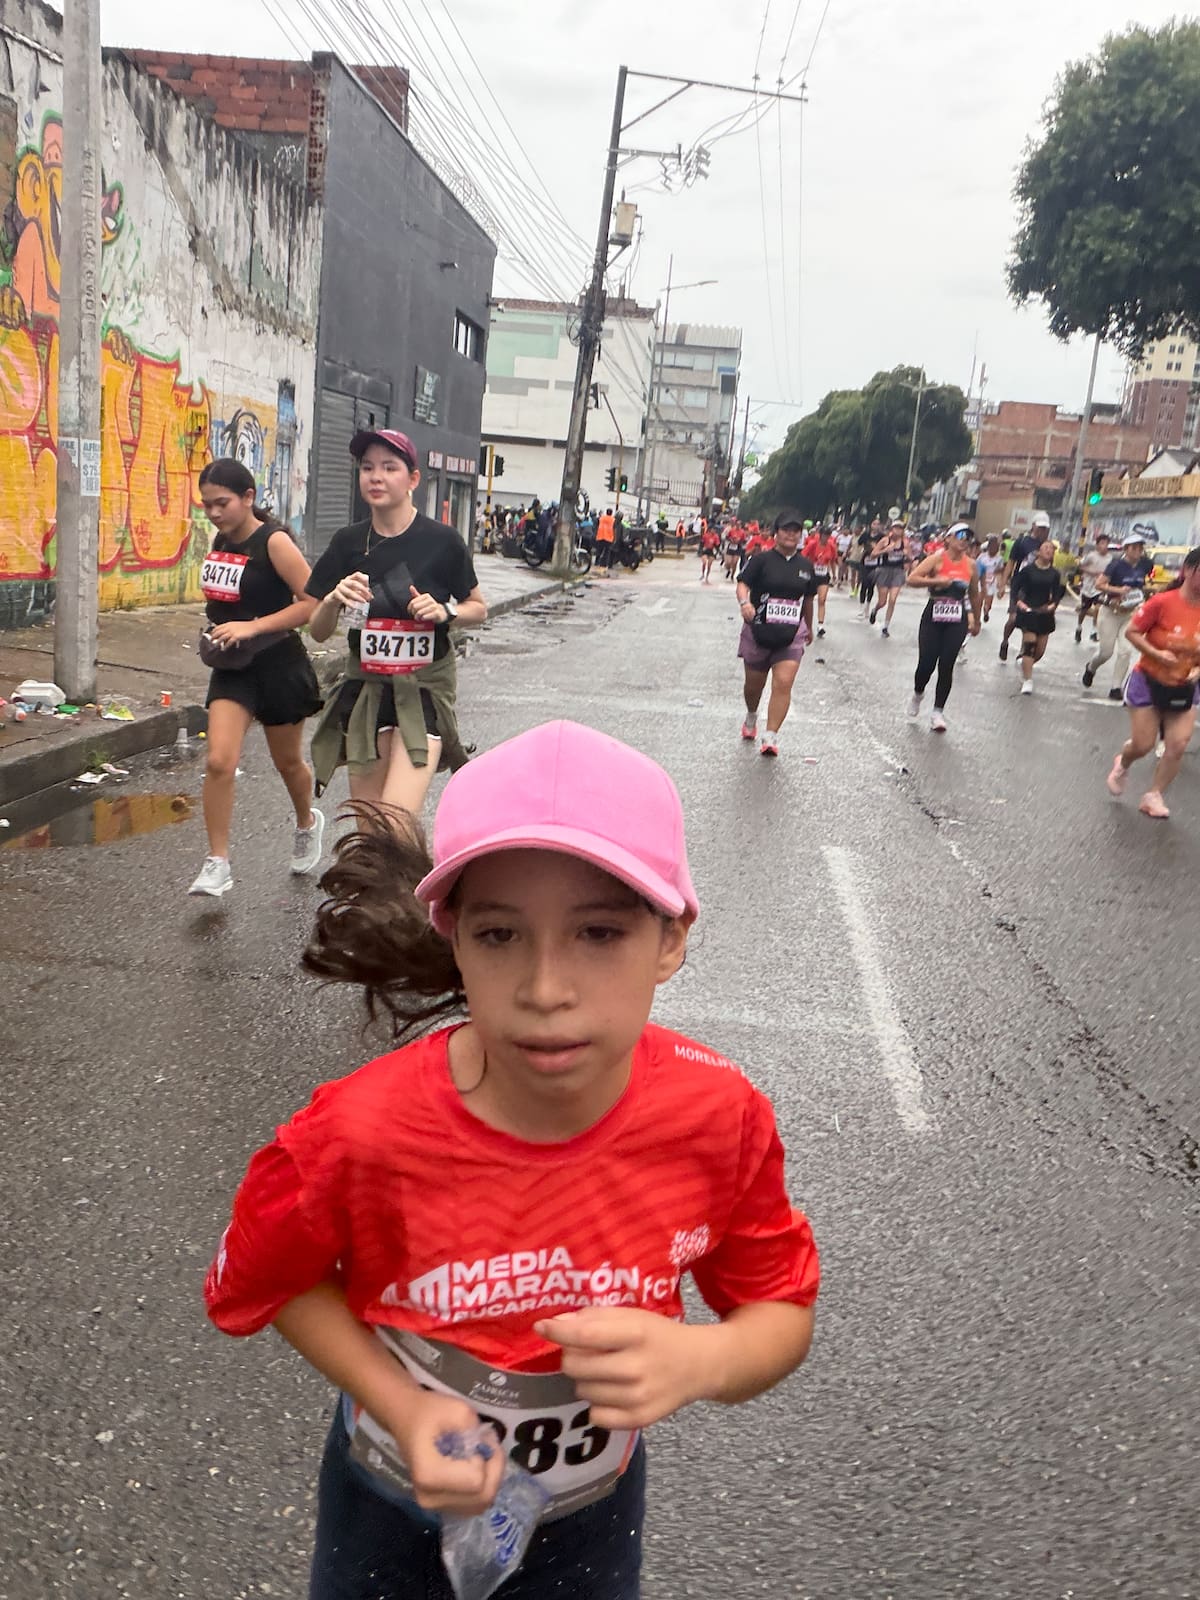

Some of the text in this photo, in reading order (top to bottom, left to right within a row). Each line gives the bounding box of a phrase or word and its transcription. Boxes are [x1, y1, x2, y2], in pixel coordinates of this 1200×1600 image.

[202, 563, 240, 587] 34714
[767, 604, 798, 617] 53828
[365, 634, 430, 657] 34713
[452, 1246, 573, 1283] MEDIA
[452, 1261, 639, 1307] MARATÓN
